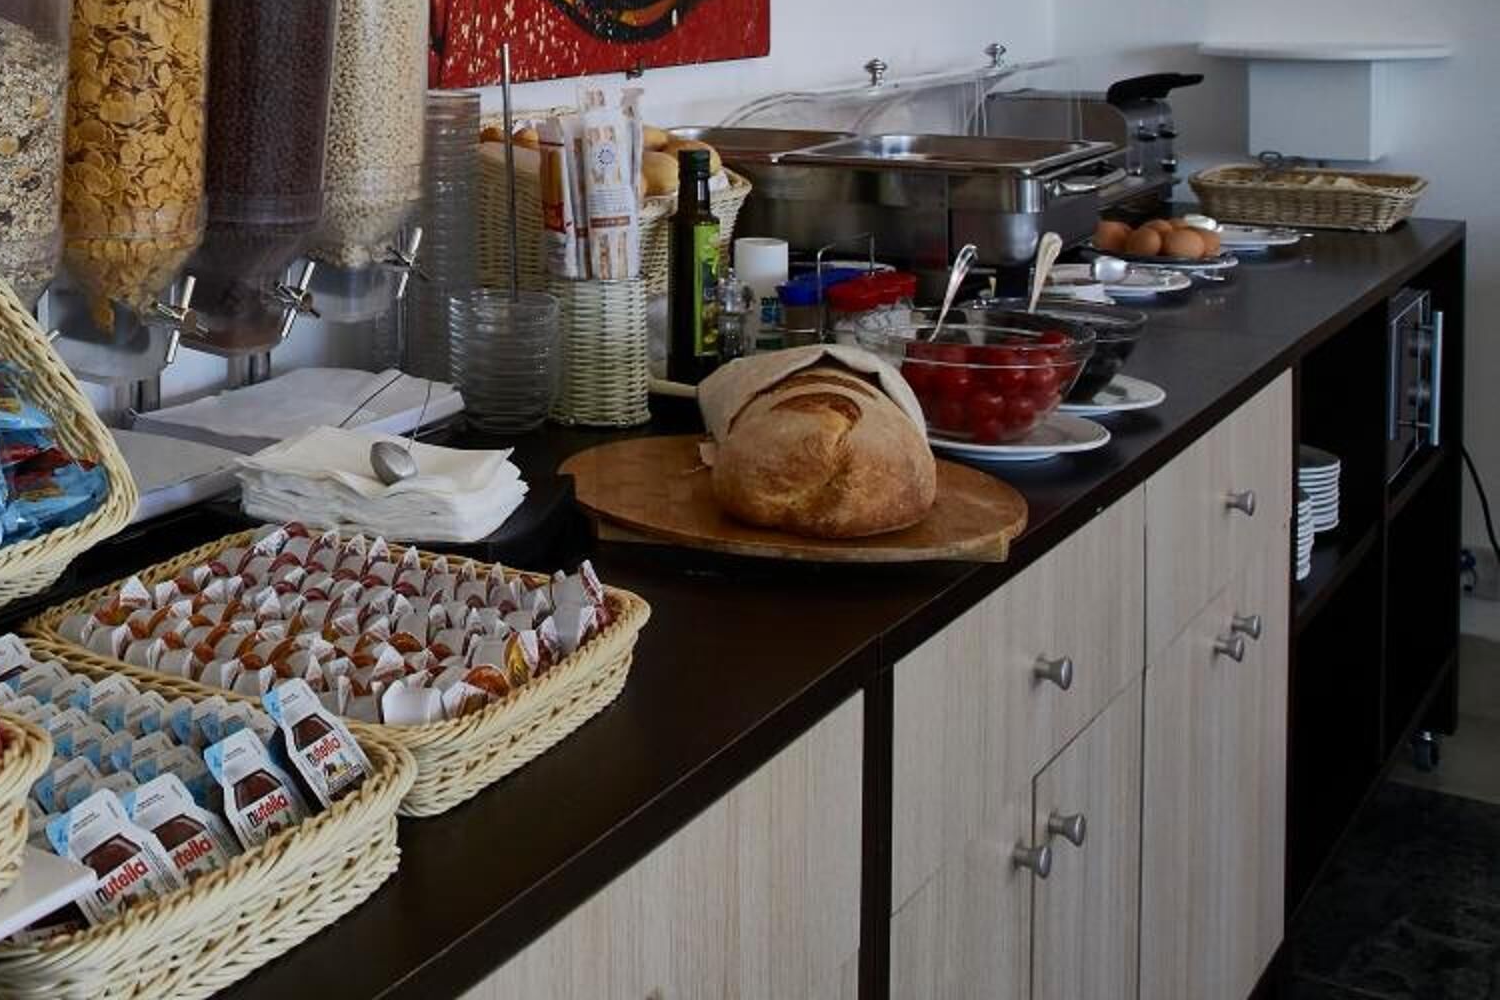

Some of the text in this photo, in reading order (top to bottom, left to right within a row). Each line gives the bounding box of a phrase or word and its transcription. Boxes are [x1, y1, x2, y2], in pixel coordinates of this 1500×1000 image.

[305, 734, 341, 766] nutella
[247, 793, 289, 829] nutella
[171, 837, 213, 870] tella
[95, 859, 149, 901] nutella
